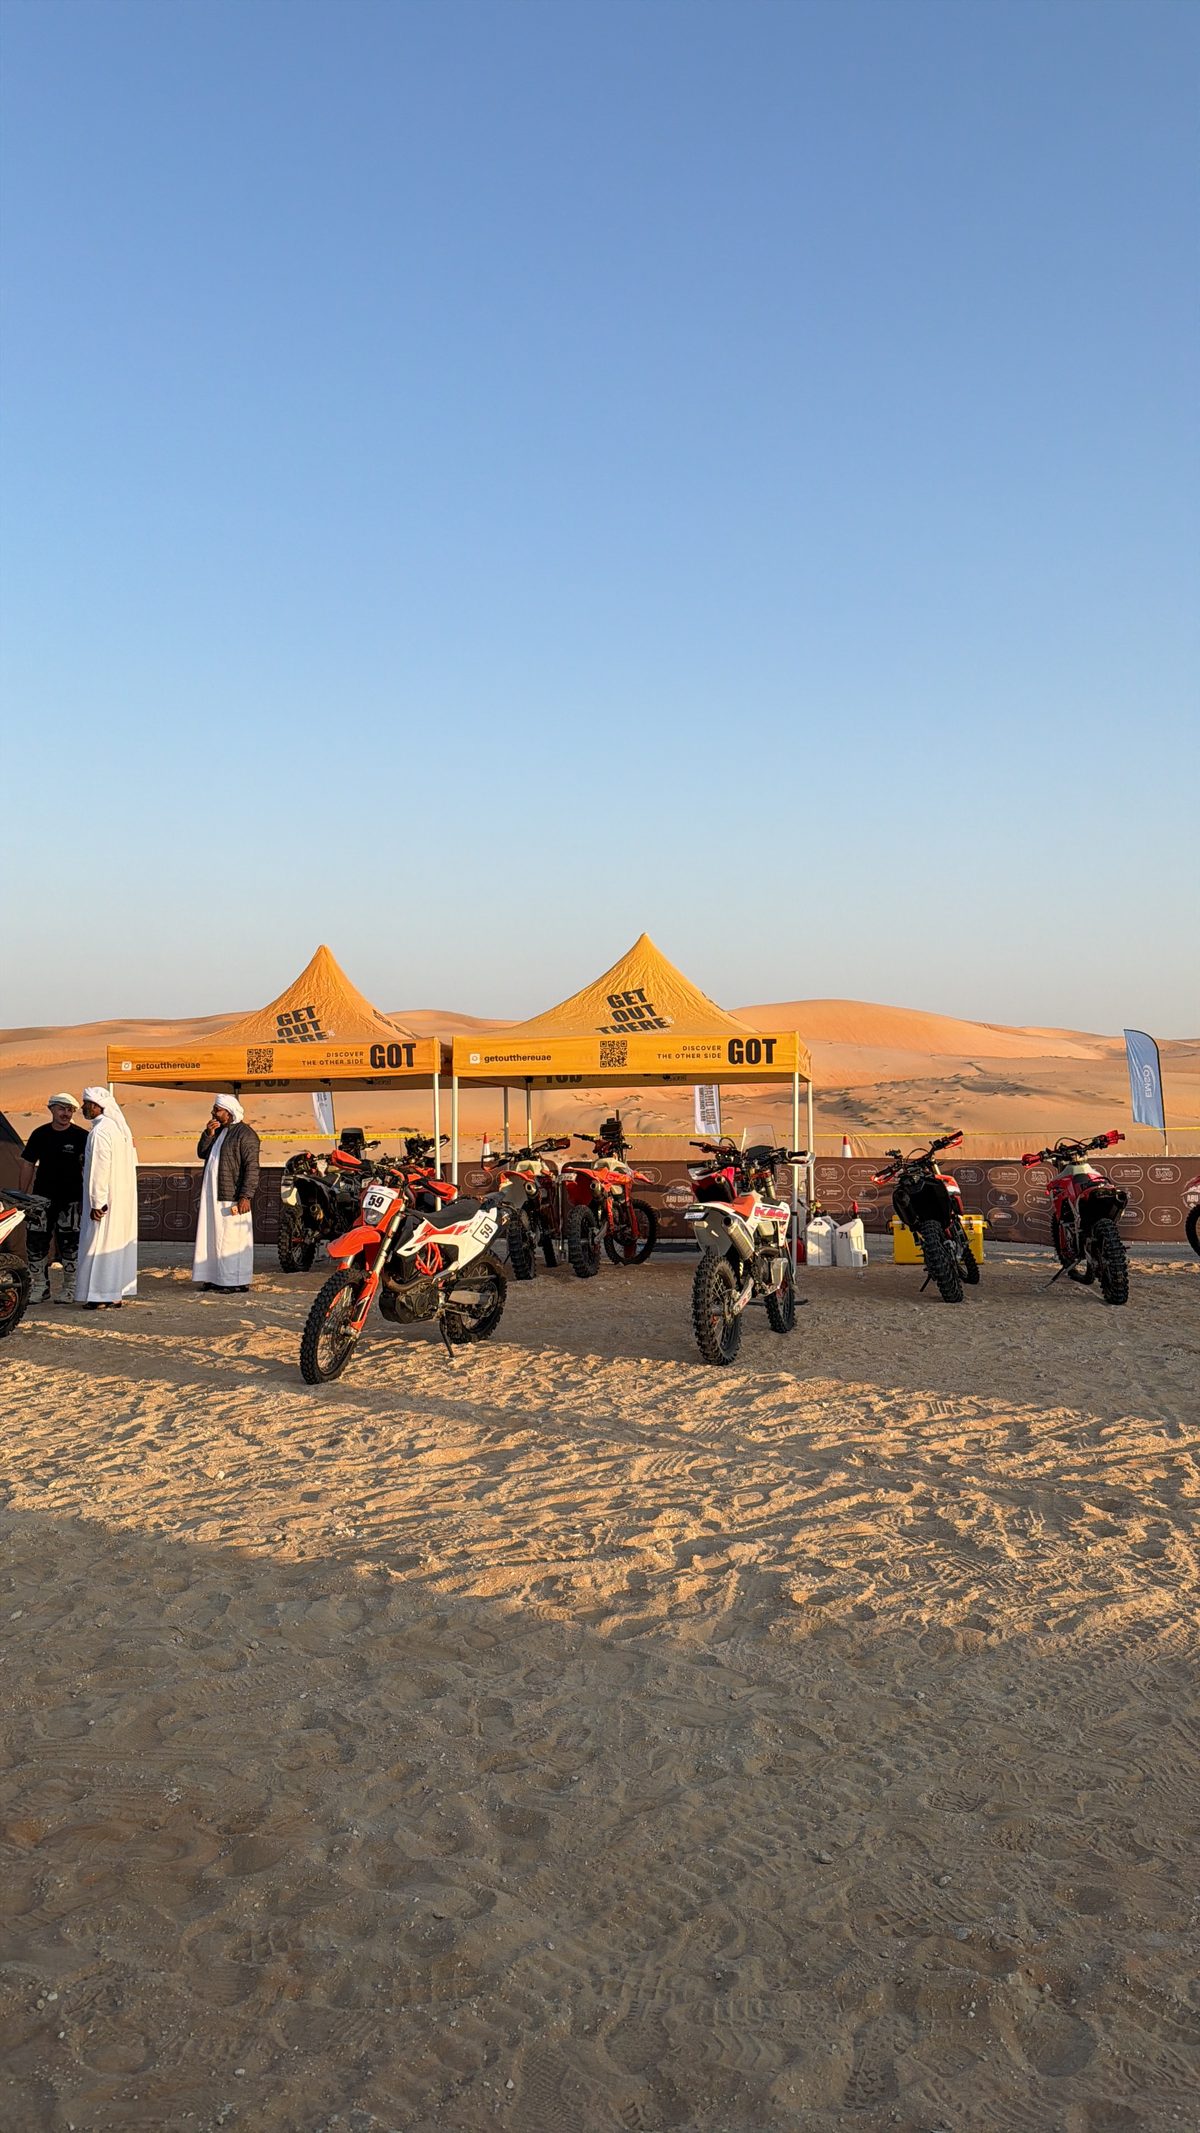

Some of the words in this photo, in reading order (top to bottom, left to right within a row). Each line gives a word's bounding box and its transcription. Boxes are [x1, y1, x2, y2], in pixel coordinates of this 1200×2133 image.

[606, 987, 647, 1009] GET
[276, 1005, 316, 1027] GET
[611, 1003, 658, 1023] OUT
[276, 1019, 321, 1038] OUT
[595, 1017, 671, 1035] THERE
[262, 1031, 330, 1044] HERE
[369, 1043, 417, 1069] GOT
[484, 1053, 552, 1063] getoutthereuae
[727, 1038, 777, 1065] GOT
[135, 1061, 201, 1071] getoutthereuae
[367, 1194, 385, 1208] 59
[479, 1223, 494, 1239] 59
